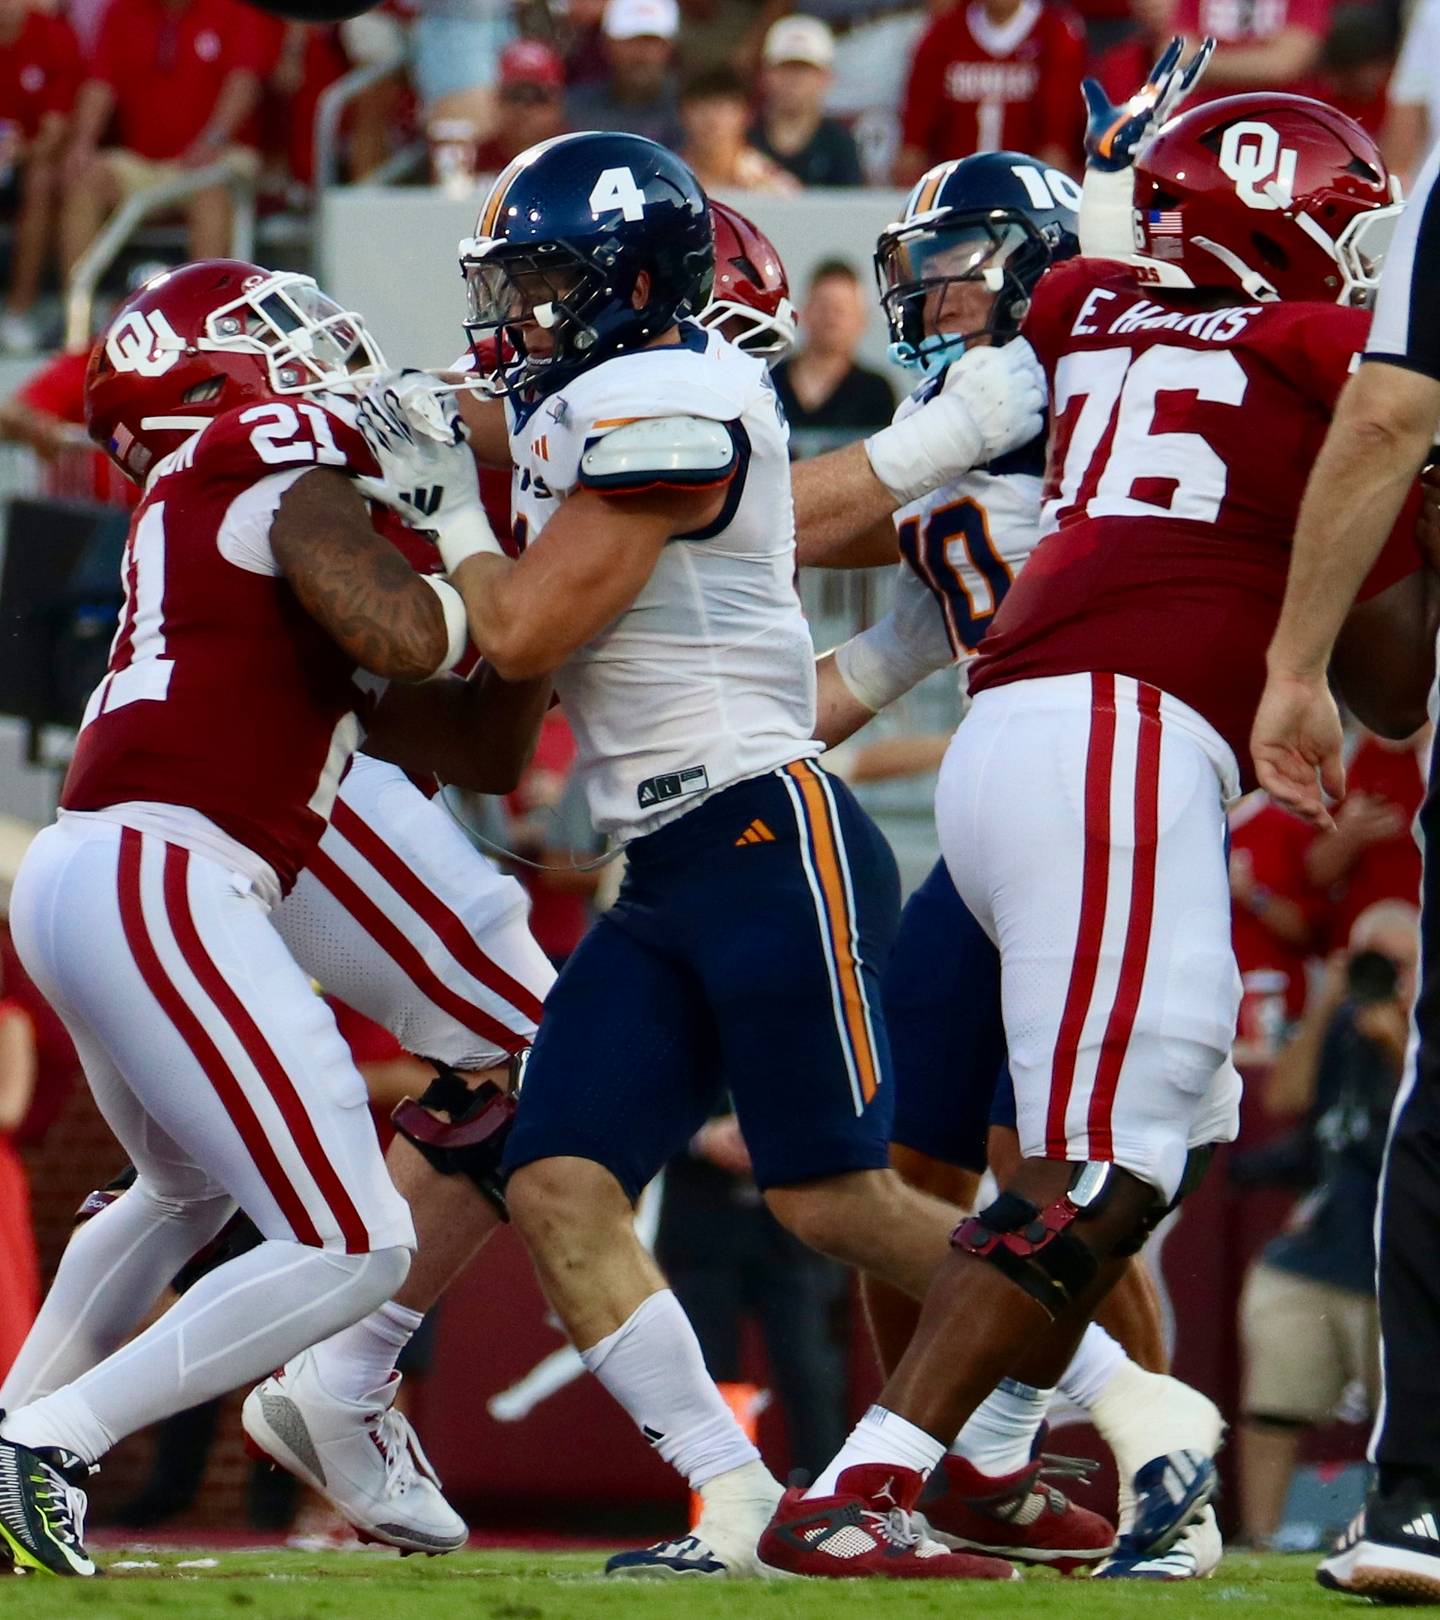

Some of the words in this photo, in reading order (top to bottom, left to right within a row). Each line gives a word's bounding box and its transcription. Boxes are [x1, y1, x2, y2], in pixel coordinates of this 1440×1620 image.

[588, 165, 647, 222] 4
[1010, 165, 1085, 213] 10
[1218, 120, 1298, 211] OU
[104, 307, 184, 378] OU
[1070, 287, 1118, 337] E.
[239, 402, 349, 466] 21
[1039, 343, 1249, 532] 76
